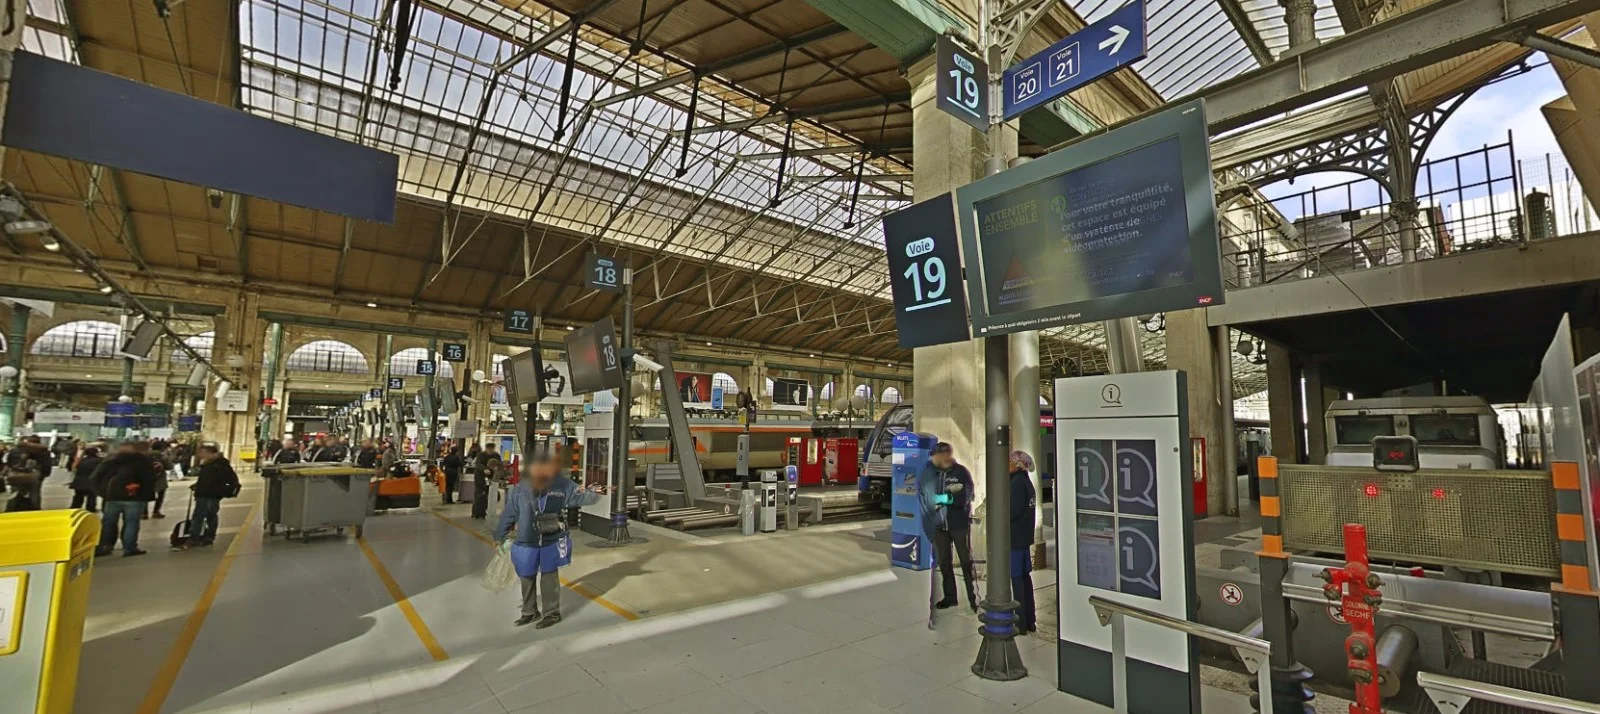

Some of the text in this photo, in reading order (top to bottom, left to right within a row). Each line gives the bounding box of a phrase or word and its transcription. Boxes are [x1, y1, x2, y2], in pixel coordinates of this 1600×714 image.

[956, 53, 973, 72] Voie
[1057, 49, 1072, 60] Voie
[1020, 69, 1034, 79] Voie
[1056, 58, 1074, 81] 21
[949, 69, 979, 109] 19
[1018, 77, 1037, 99] 20
[984, 200, 1038, 225] ATTENTIFS
[1061, 222, 1077, 232] cet
[1078, 212, 1110, 227] espace
[1112, 207, 1129, 219] est
[1130, 196, 1167, 214] équipé
[1082, 201, 1108, 214] votre
[985, 211, 1039, 236] ENSEMBLE
[1126, 217, 1141, 227] de
[909, 241, 930, 255] Voie
[594, 266, 617, 284] 18
[903, 256, 947, 302] 19
[511, 316, 529, 328] 17
[447, 348, 461, 358] 16
[604, 344, 616, 367] 18
[421, 365, 433, 373] 15
